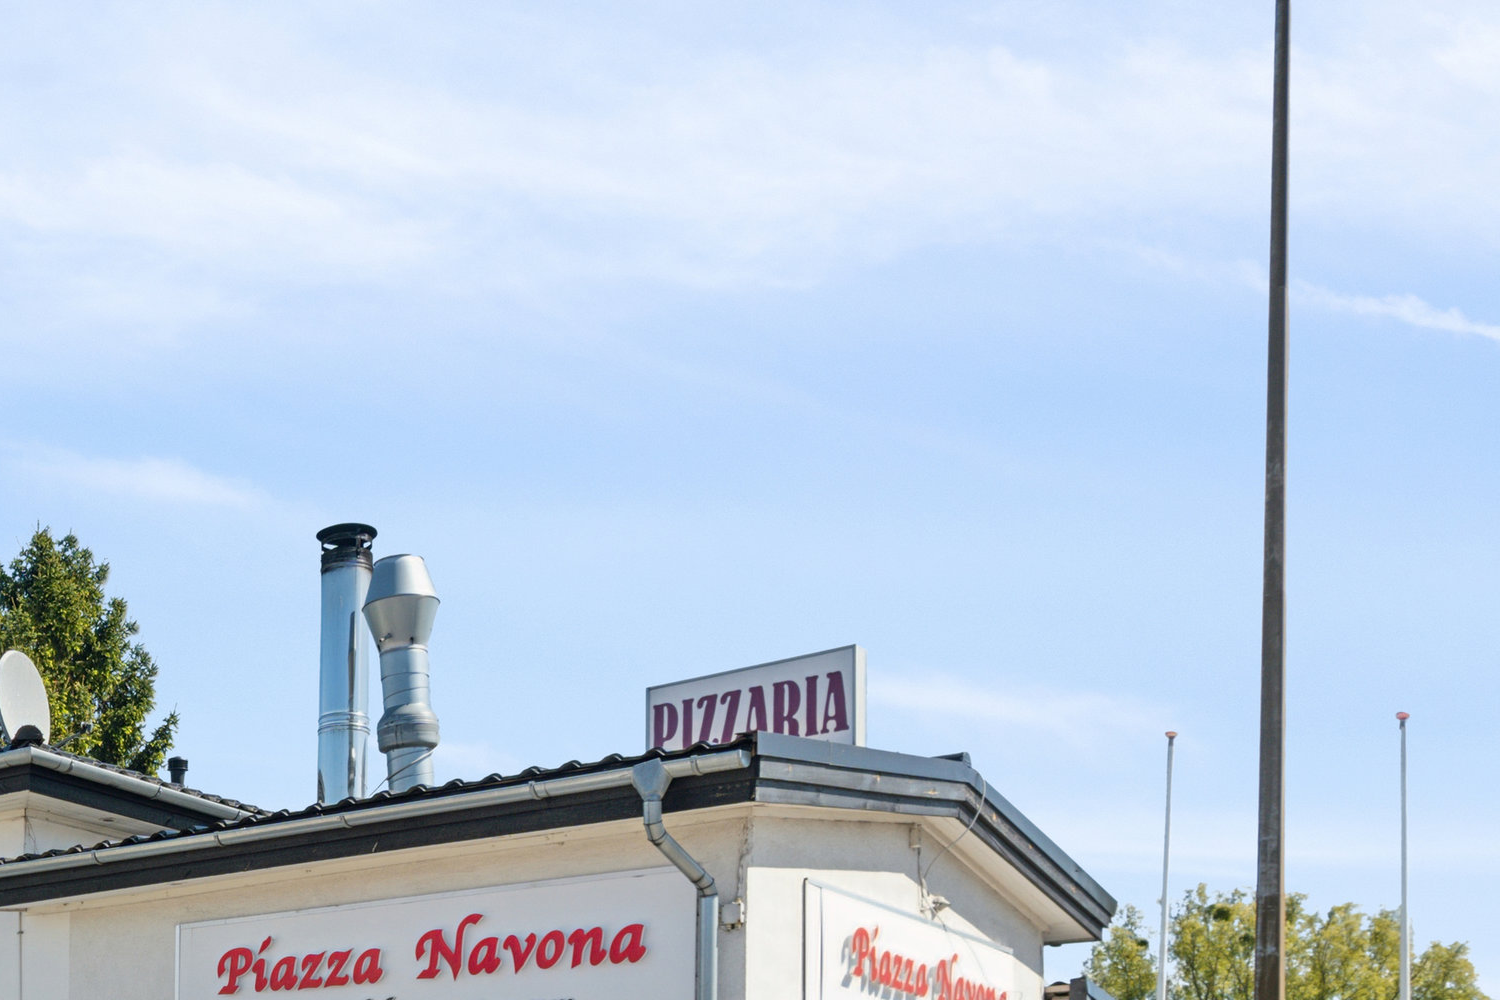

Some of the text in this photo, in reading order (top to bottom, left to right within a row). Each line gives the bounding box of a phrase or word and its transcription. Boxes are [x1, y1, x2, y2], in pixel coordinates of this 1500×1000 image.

[653, 671, 849, 749] PIZZARIA
[217, 913, 647, 995] Piazza Navona
[851, 924, 928, 998] Piazza
